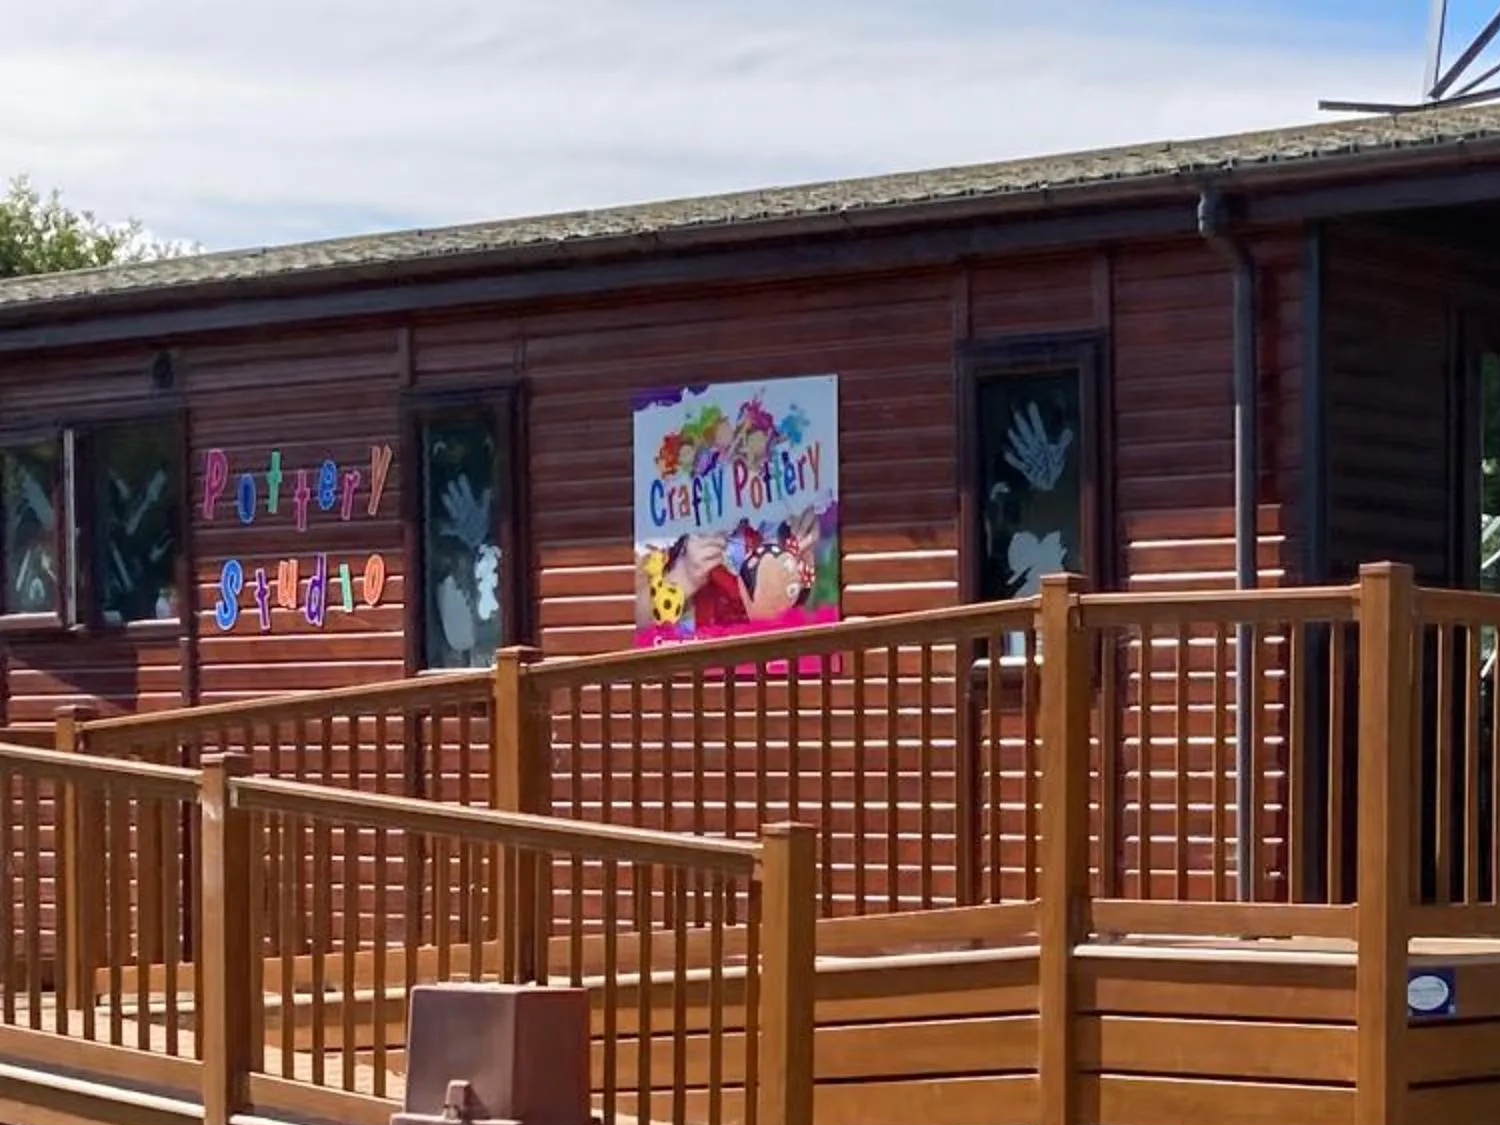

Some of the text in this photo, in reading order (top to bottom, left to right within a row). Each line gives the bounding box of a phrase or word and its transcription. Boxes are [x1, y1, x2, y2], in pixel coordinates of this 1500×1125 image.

[203, 444, 392, 532] Pottery
[650, 440, 821, 527] Crafty Pottery
[215, 552, 385, 631] Studio
